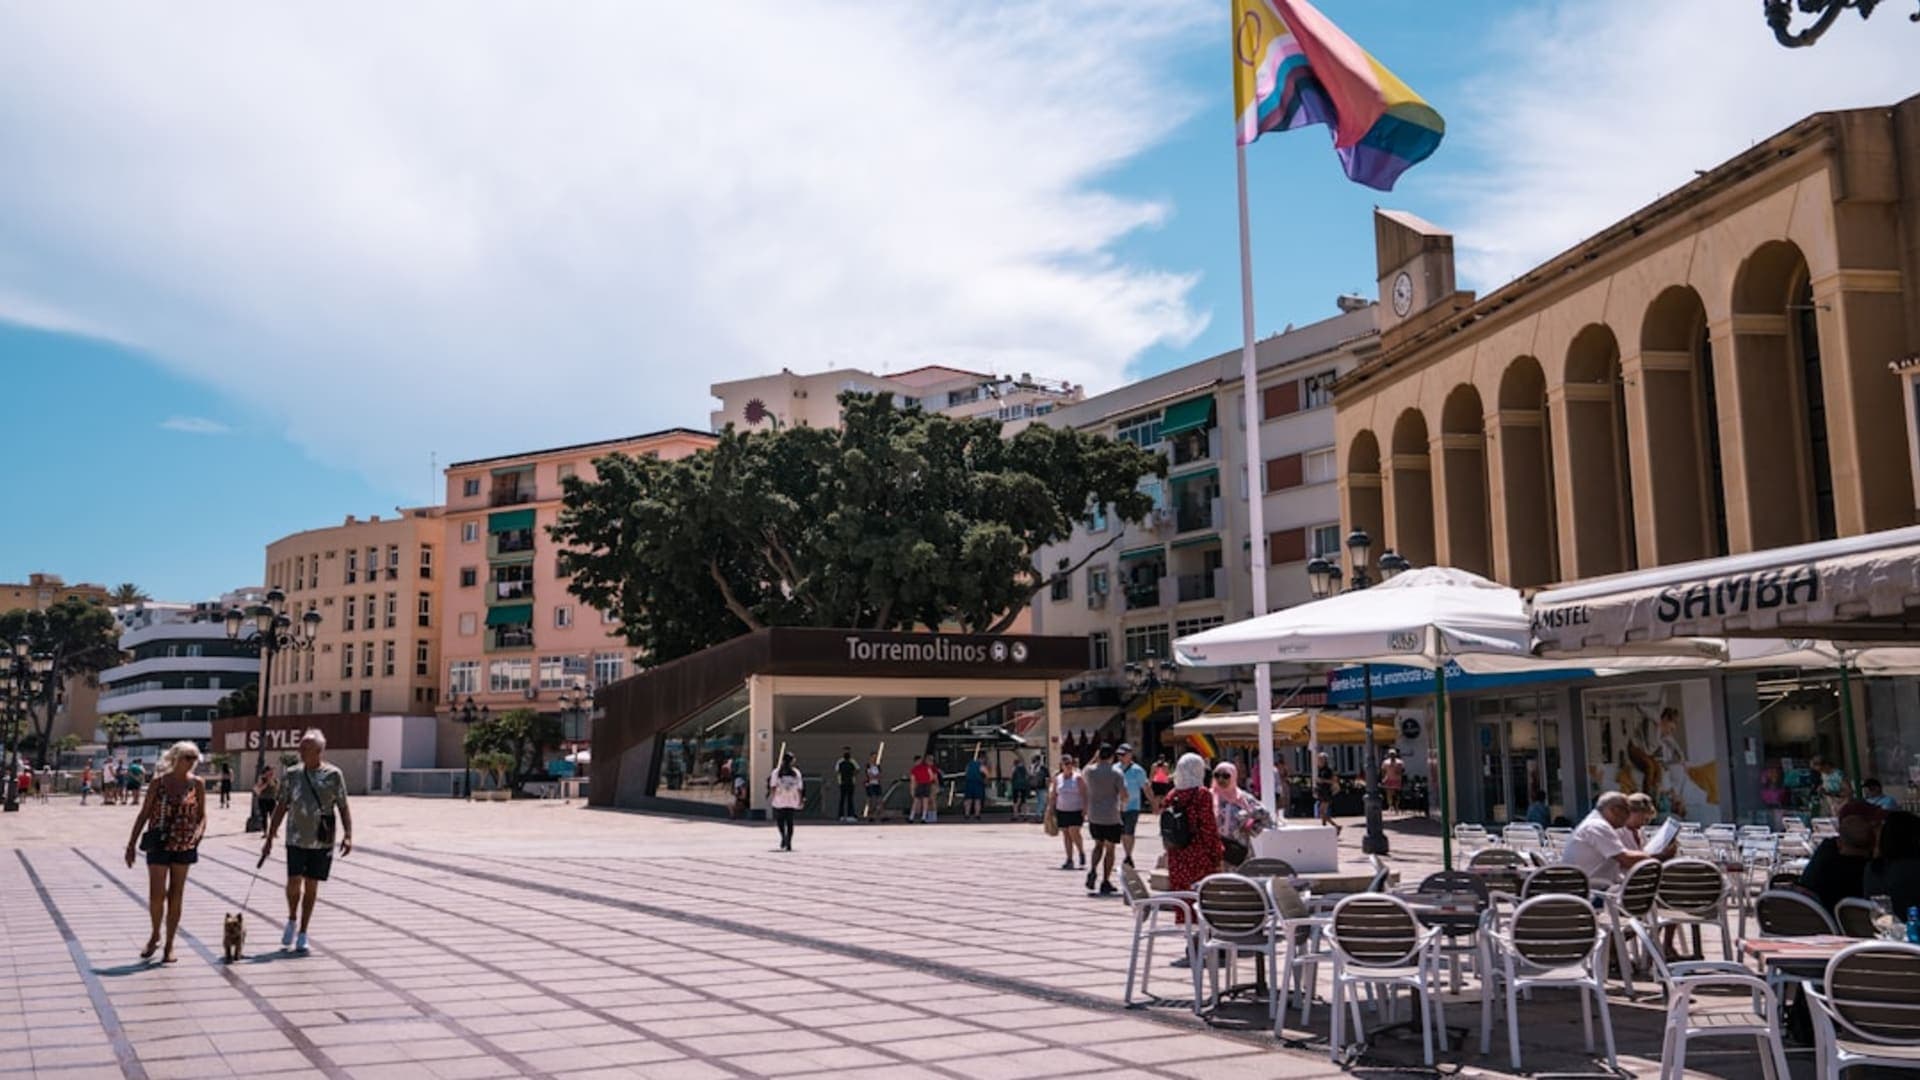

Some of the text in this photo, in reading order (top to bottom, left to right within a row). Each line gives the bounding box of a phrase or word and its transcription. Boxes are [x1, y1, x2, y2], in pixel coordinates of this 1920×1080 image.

[1658, 565, 1818, 622] SAMBA
[1531, 605, 1589, 630] AMSTEL
[846, 636, 986, 662] Torremolinos
[248, 729, 301, 749] SYLE
